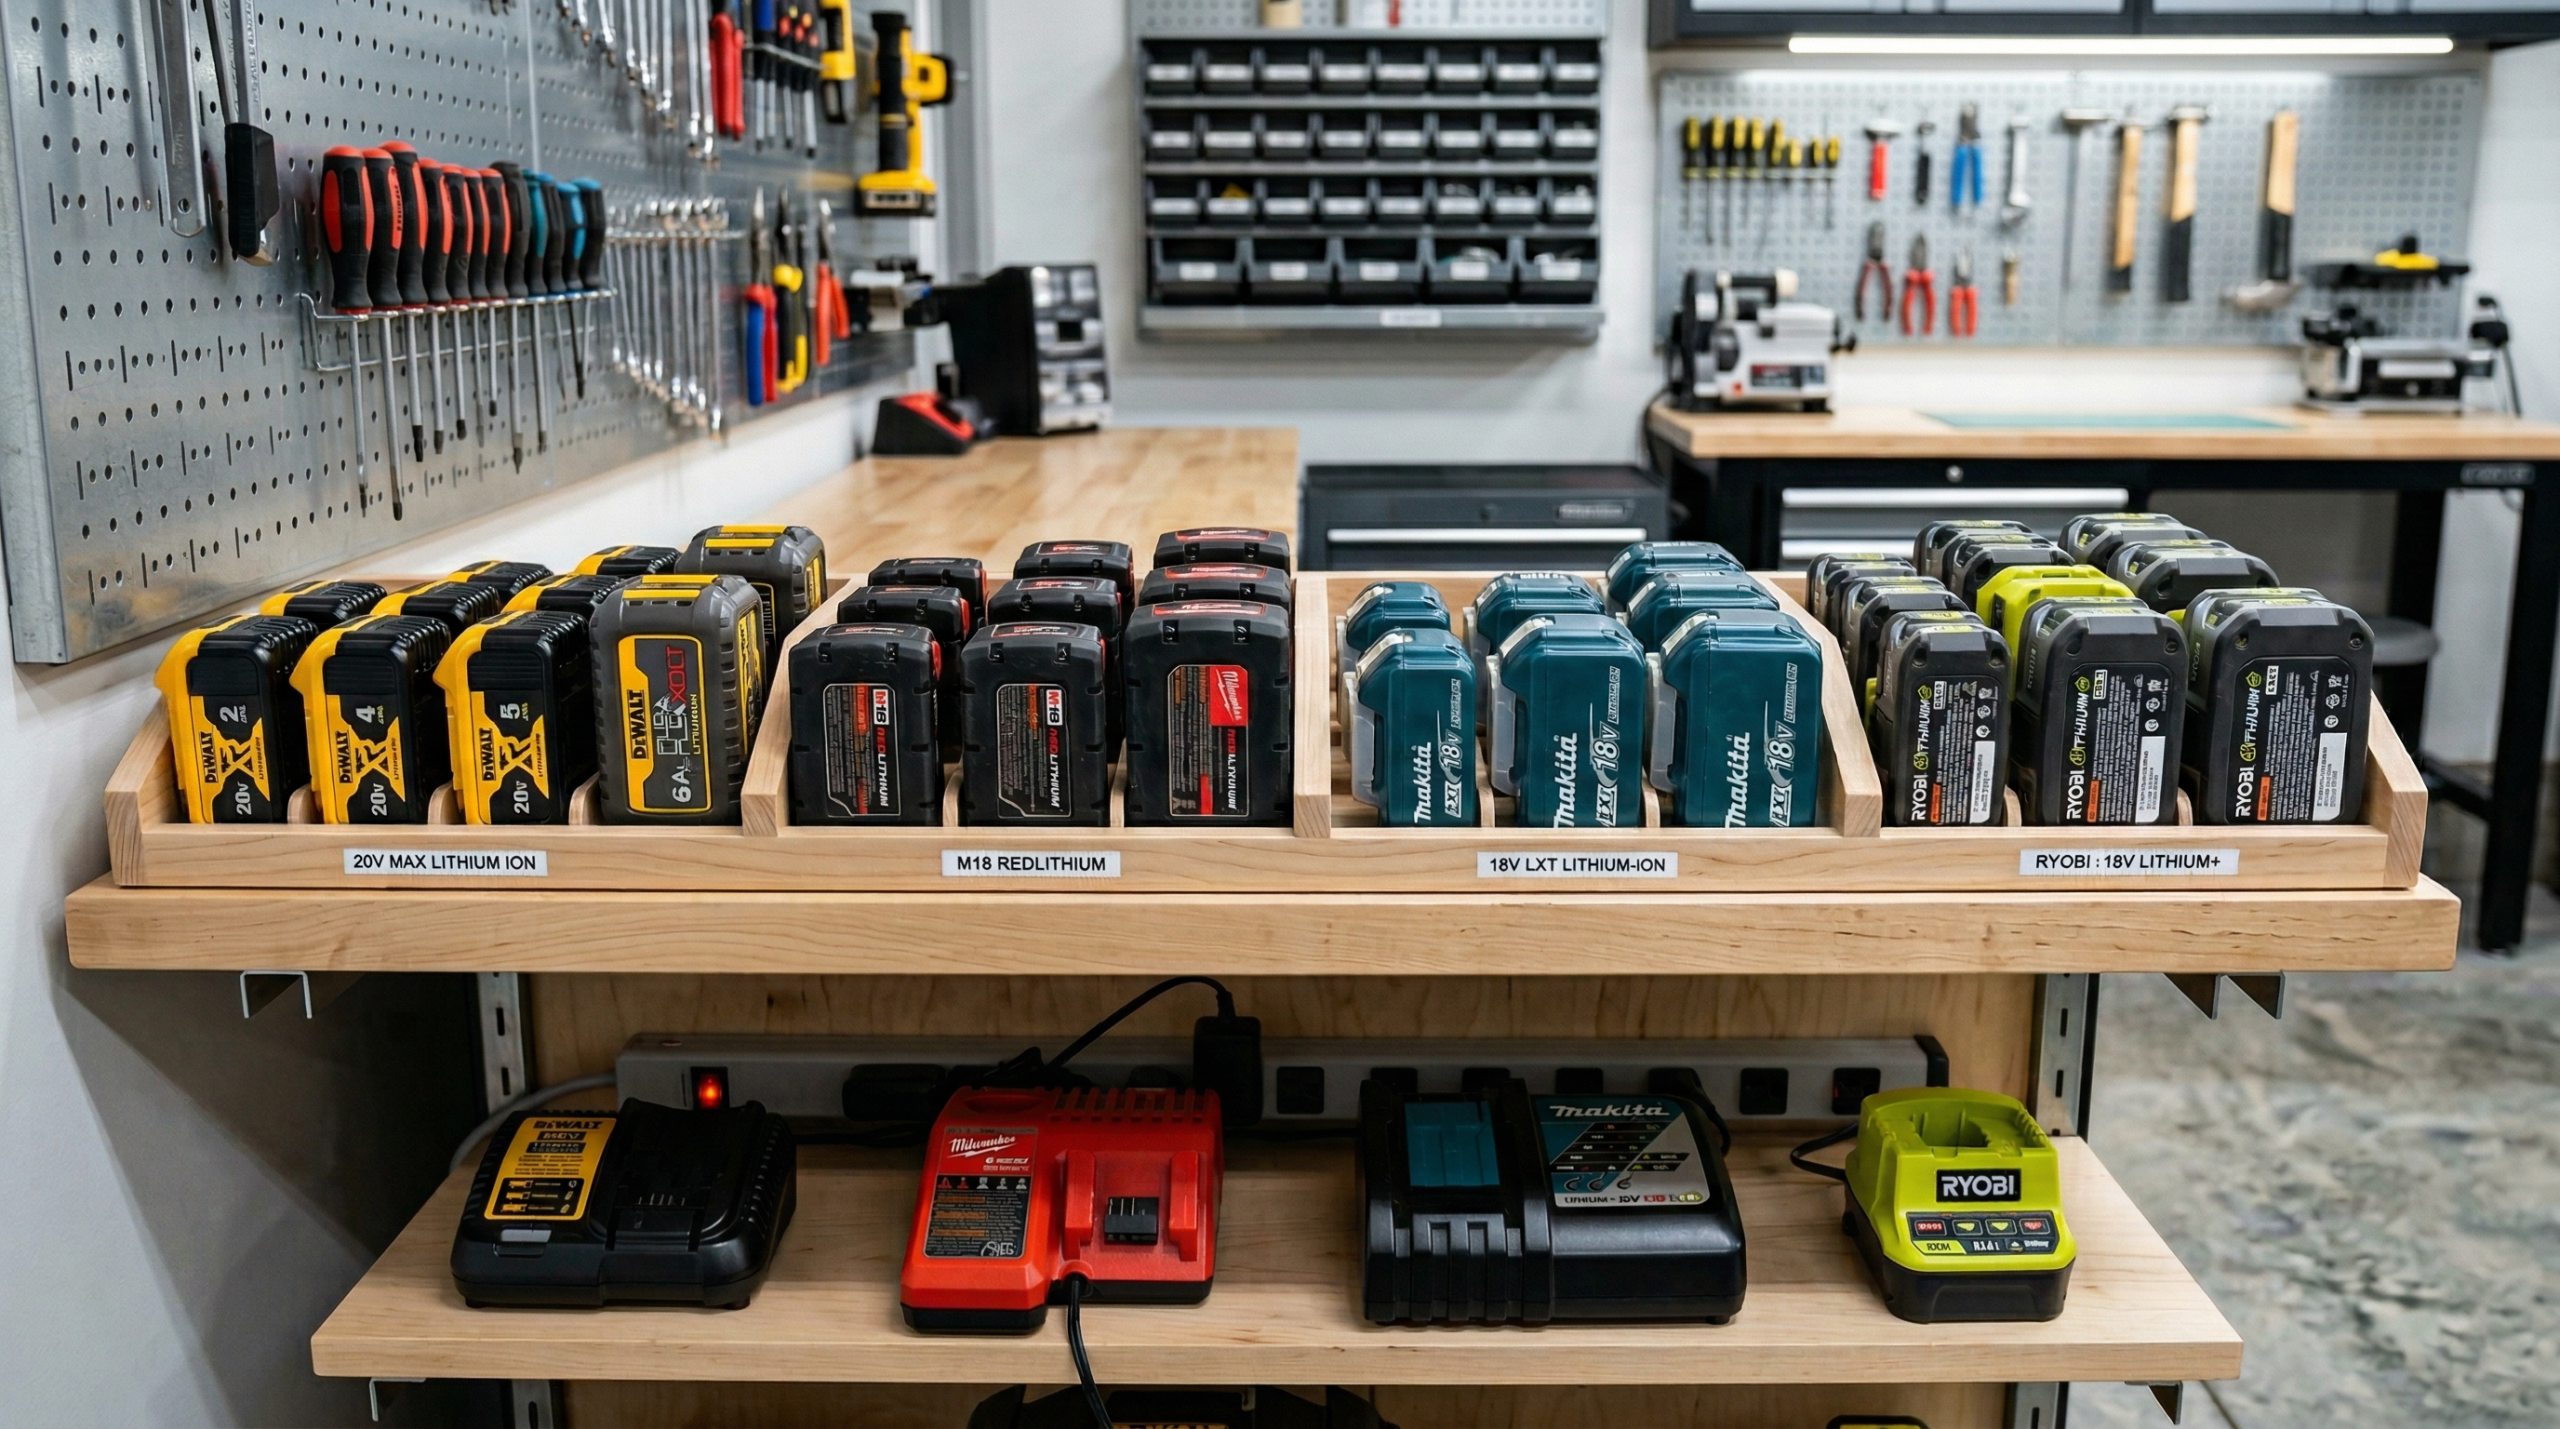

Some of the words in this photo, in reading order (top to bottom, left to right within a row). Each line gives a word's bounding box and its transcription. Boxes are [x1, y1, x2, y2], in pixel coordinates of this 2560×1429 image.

[219, 705, 239, 722] 2
[355, 705, 376, 723] 4
[500, 703, 520, 719] 5
[627, 690, 649, 760] DEWALT
[1912, 774, 1928, 821] RYOBI
[2067, 769, 2085, 820] RYOBI
[2235, 765, 2255, 818] RYOBI
[353, 854, 384, 868] 20V
[390, 855, 427, 869] MAX
[431, 855, 500, 870] LITHIUM
[506, 856, 536, 870] ION
[957, 856, 992, 870] M18
[998, 856, 1106, 871] REDLITHIUM
[1490, 857, 1521, 872] 18V
[1525, 858, 1558, 872] LXT
[1562, 858, 1666, 872] LITHIUM-ION
[2036, 854, 2091, 869] RYOBI
[2104, 854, 2135, 869] 18V
[2139, 854, 2221, 869] LITHIUM+
[1941, 1175, 2015, 1197] RYOBI
